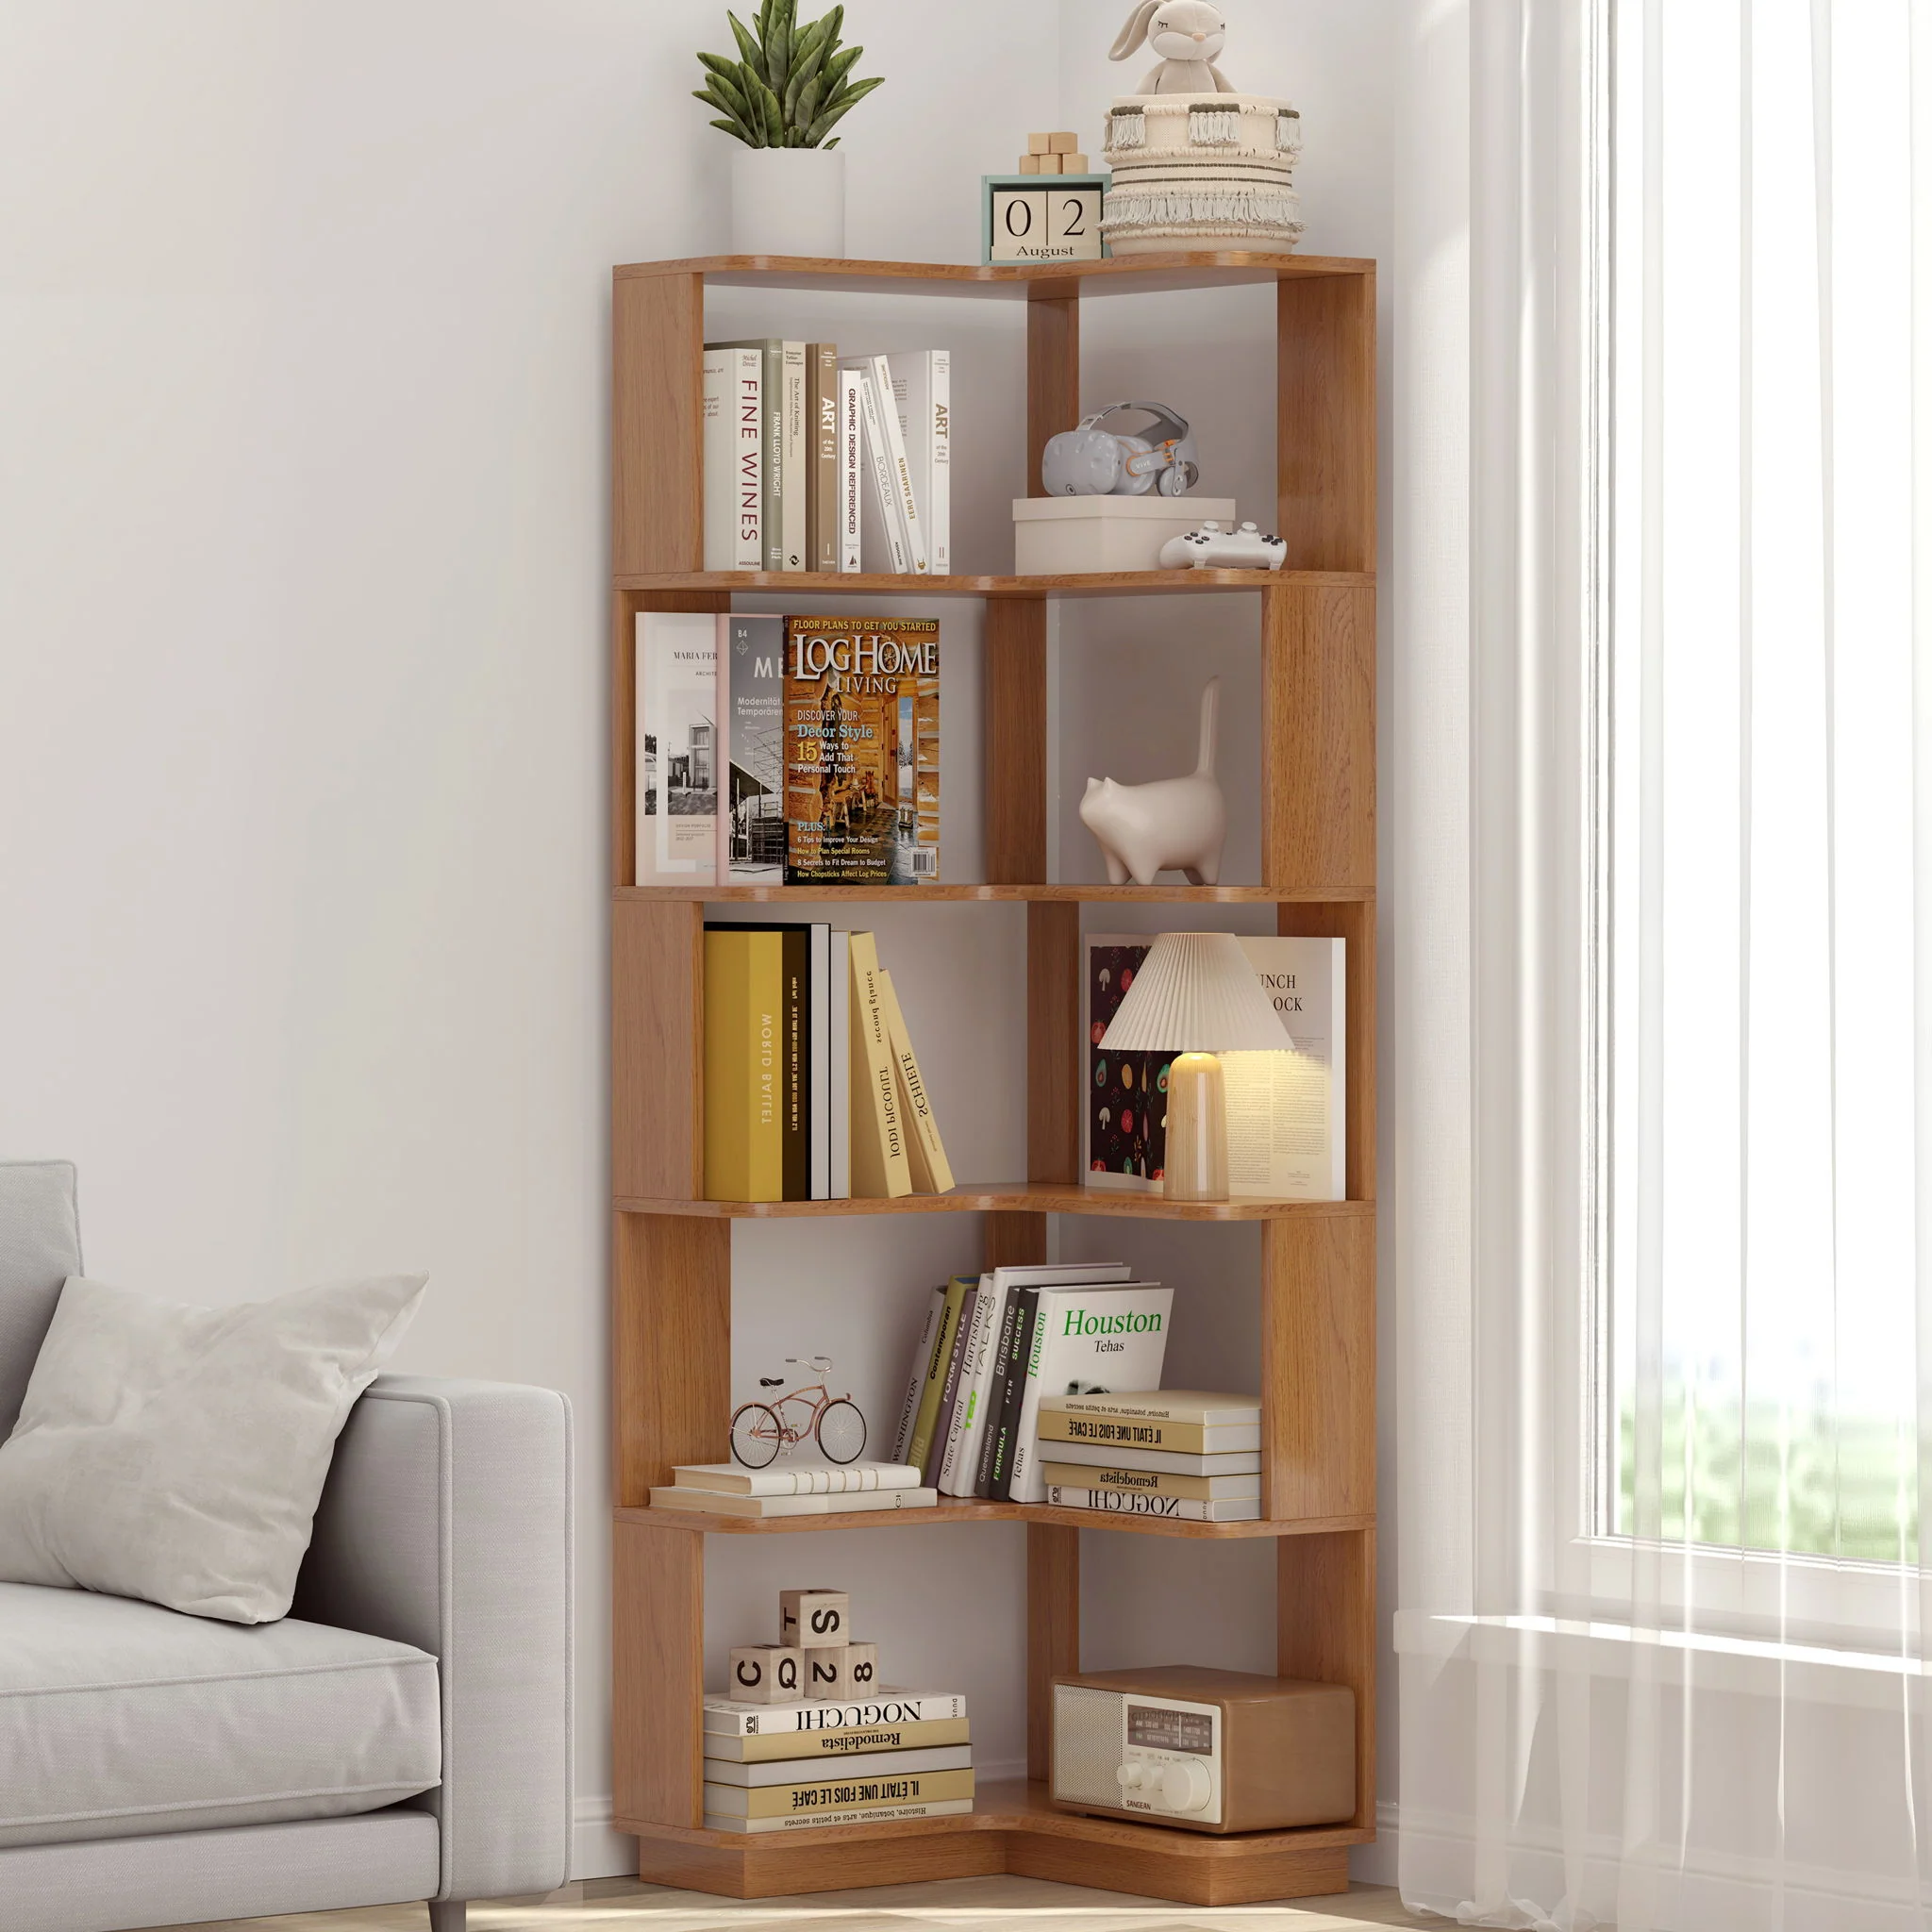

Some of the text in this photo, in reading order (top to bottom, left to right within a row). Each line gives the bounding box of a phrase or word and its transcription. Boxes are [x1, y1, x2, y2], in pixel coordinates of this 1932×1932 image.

[1016, 245, 1074, 259] August
[741, 379, 758, 440] FINE
[822, 396, 836, 434] ART
[848, 388, 857, 431] GRAPHIC
[935, 403, 948, 439] ART
[848, 434, 857, 469] DESIGN
[876, 456, 892, 507] BORDEAUX
[897, 457, 916, 520] EERO SAARINEN
[741, 452, 758, 541] WINES
[848, 472, 857, 535] REFERENCED
[793, 620, 937, 631] FLOOR PLANS TO GET YOU STARTED
[674, 651, 700, 660] MARIA
[837, 676, 897, 693] LIVING
[797, 710, 858, 721] DISCOVER YOUR
[797, 724, 874, 741] Decor Style
[819, 741, 839, 751] Ways
[797, 741, 818, 761] 15
[819, 753, 854, 762] Add That
[797, 764, 856, 774] Personal Touch
[797, 822, 826, 831] PLUS:
[962, 1291, 990, 1376] Harrisburg
[1062, 1309, 1162, 1336] Houston
[943, 1312, 967, 1403] FORM STYLE
[1027, 1311, 1046, 1378] Houston
[1094, 1340, 1124, 1353] Tehas
[978, 1304, 1015, 1483] Queensland Brisbane
[993, 1307, 1024, 1481] FORMULA FOR SUCCESS
[892, 1376, 919, 1461] WASHINGTON
[943, 1399, 964, 1476] State Capital
[1013, 1446, 1025, 1479] Tehas
[811, 1608, 841, 1635] S
[778, 1657, 797, 1690] Q
[812, 1661, 837, 1684] 2
[854, 1661, 873, 1683] 8
[795, 1701, 922, 1731] NOGUCHI
[821, 1732, 901, 1751] Remodelista
[791, 1780, 920, 1810] IL ÉTAIT UNE FOIS LE CAFÉ
[811, 1816, 832, 1824] petits
[841, 1813, 858, 1822] arts
[858, 1809, 895, 1821] botanique,
[896, 1807, 926, 1816] Histoire,
